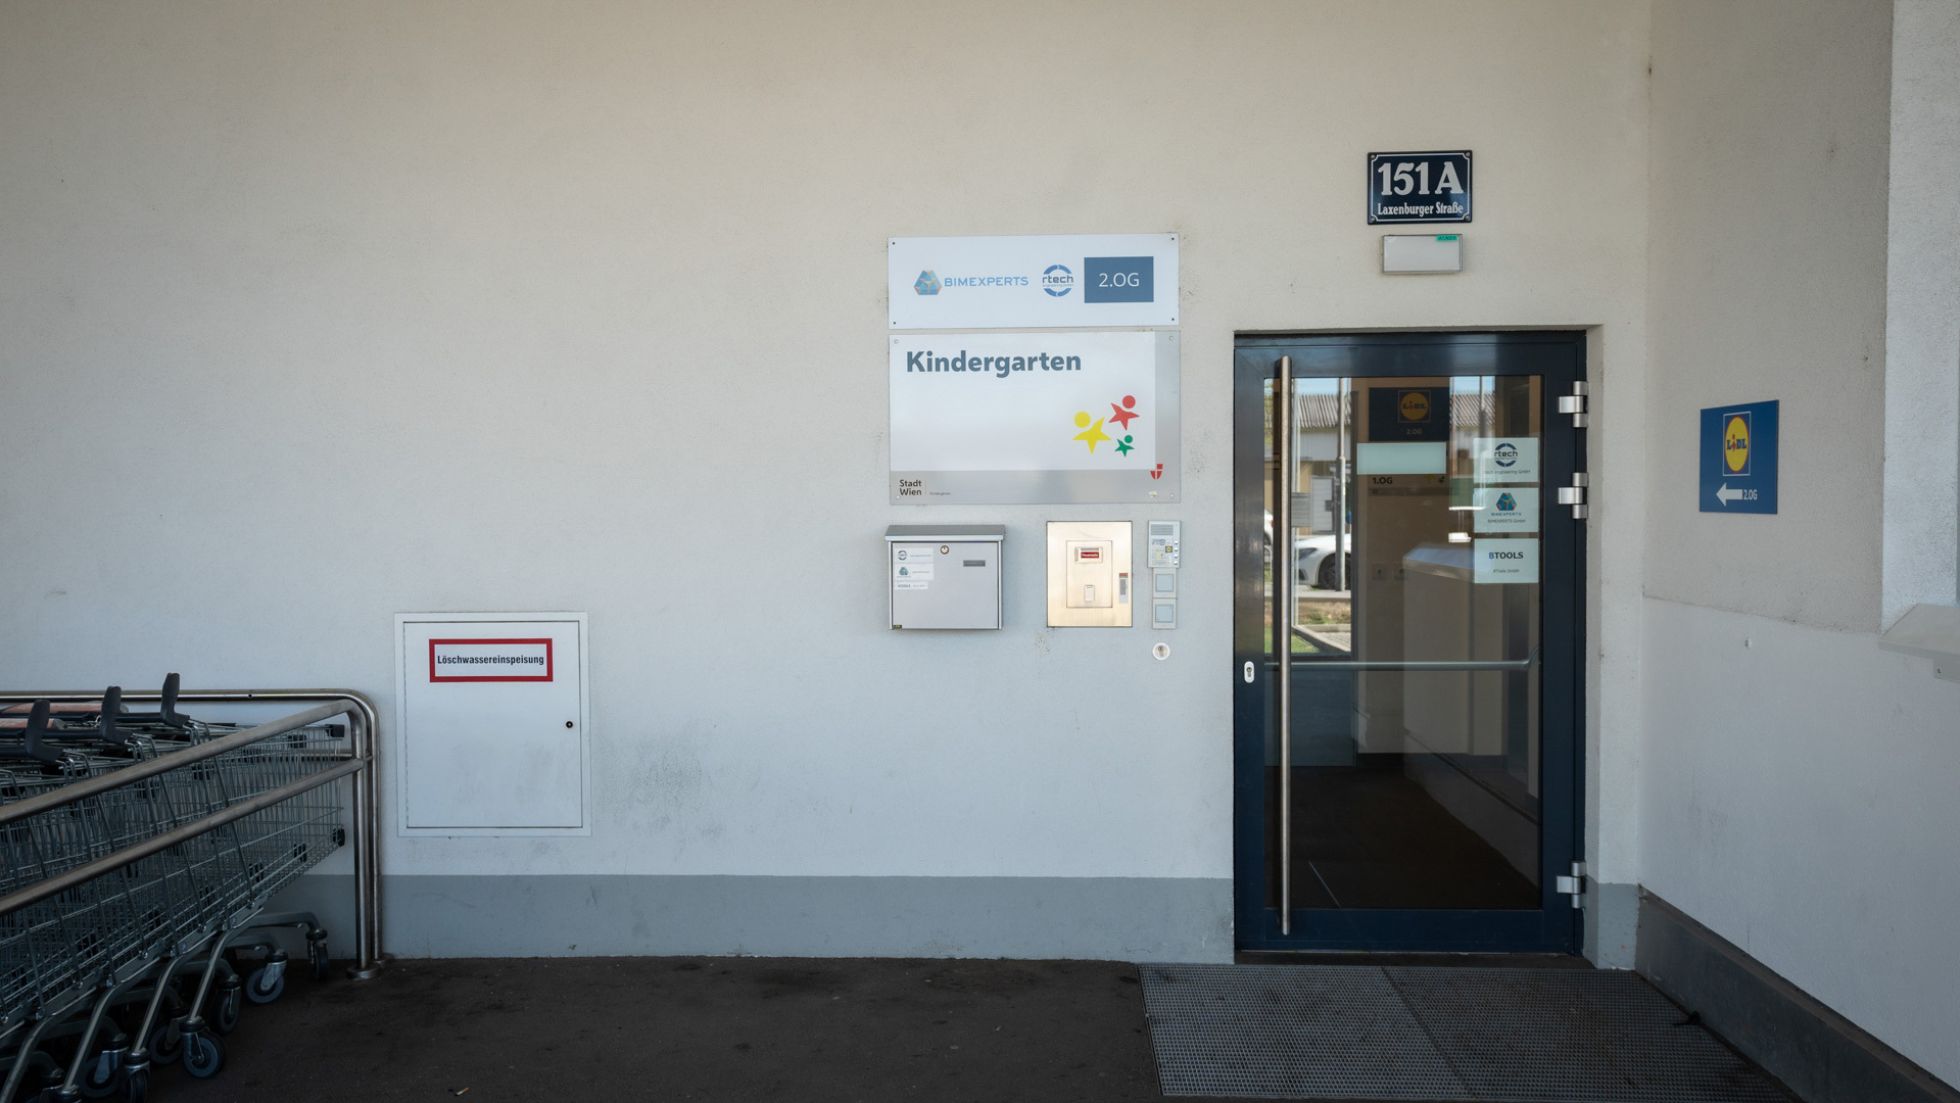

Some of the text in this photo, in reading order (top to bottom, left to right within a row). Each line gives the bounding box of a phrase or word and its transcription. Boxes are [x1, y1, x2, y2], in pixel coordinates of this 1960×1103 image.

[1377, 161, 1465, 196] 151 A
[1377, 201, 1464, 218] Laxenburger Straße
[944, 276, 1029, 287] BIMEXPERTS
[1042, 275, 1074, 284] rtech
[1098, 272, 1140, 288] 2.OG
[906, 350, 1082, 379] Kindergarten
[1494, 450, 1519, 458] rtech
[899, 479, 923, 488] Stadt
[1372, 476, 1393, 486] 1.OG
[899, 487, 923, 497] Wien
[436, 654, 545, 666] Löschwassereinspeisung
